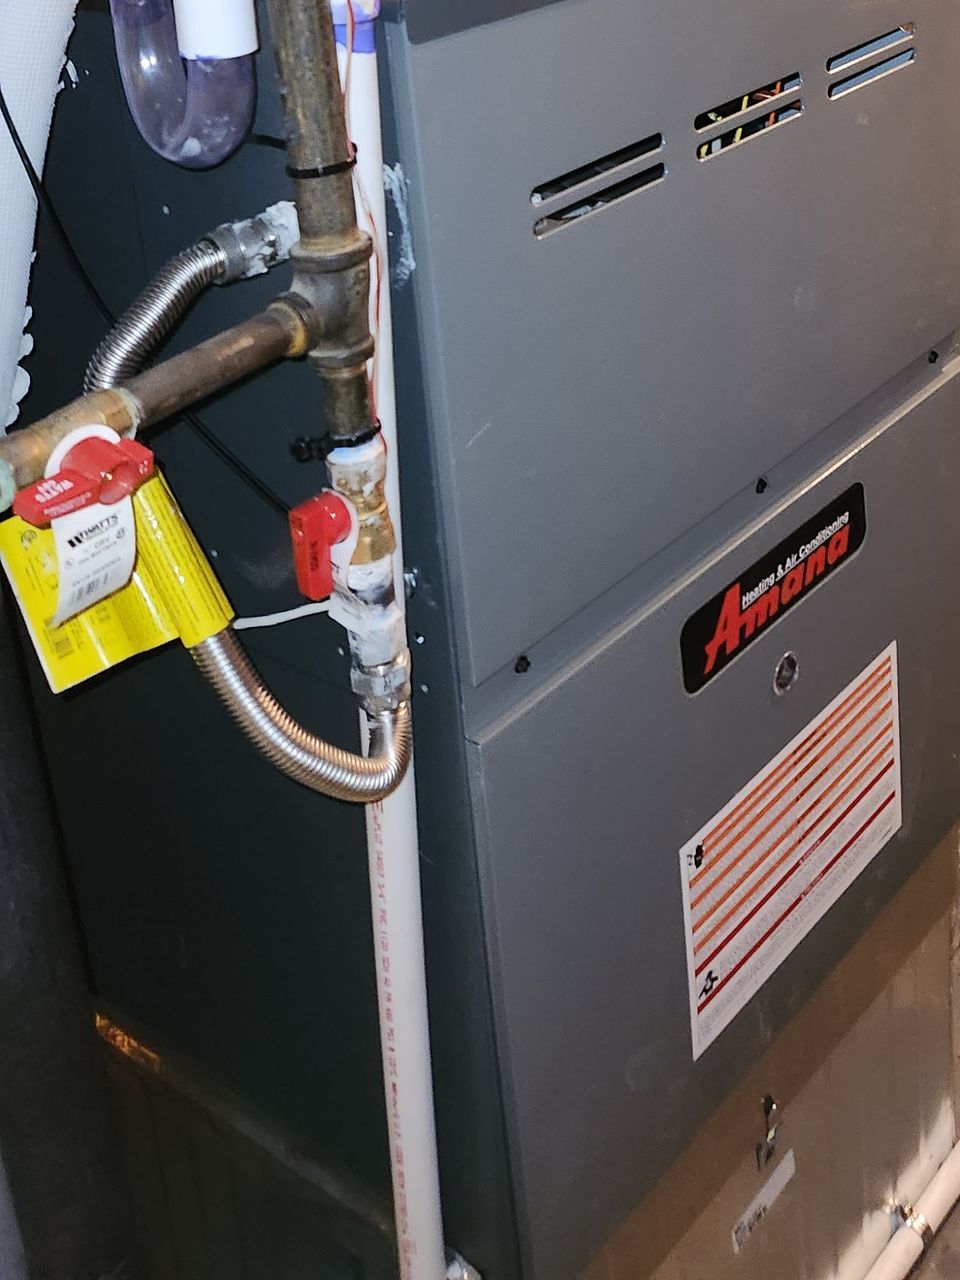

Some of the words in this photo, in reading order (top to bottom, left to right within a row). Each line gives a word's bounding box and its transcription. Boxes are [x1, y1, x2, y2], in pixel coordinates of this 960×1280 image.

[704, 524, 850, 674] Amana
[741, 572, 775, 610] Heating
[775, 563, 784, 579] &
[784, 552, 798, 570] Air
[799, 511, 850, 558] Conditioning
